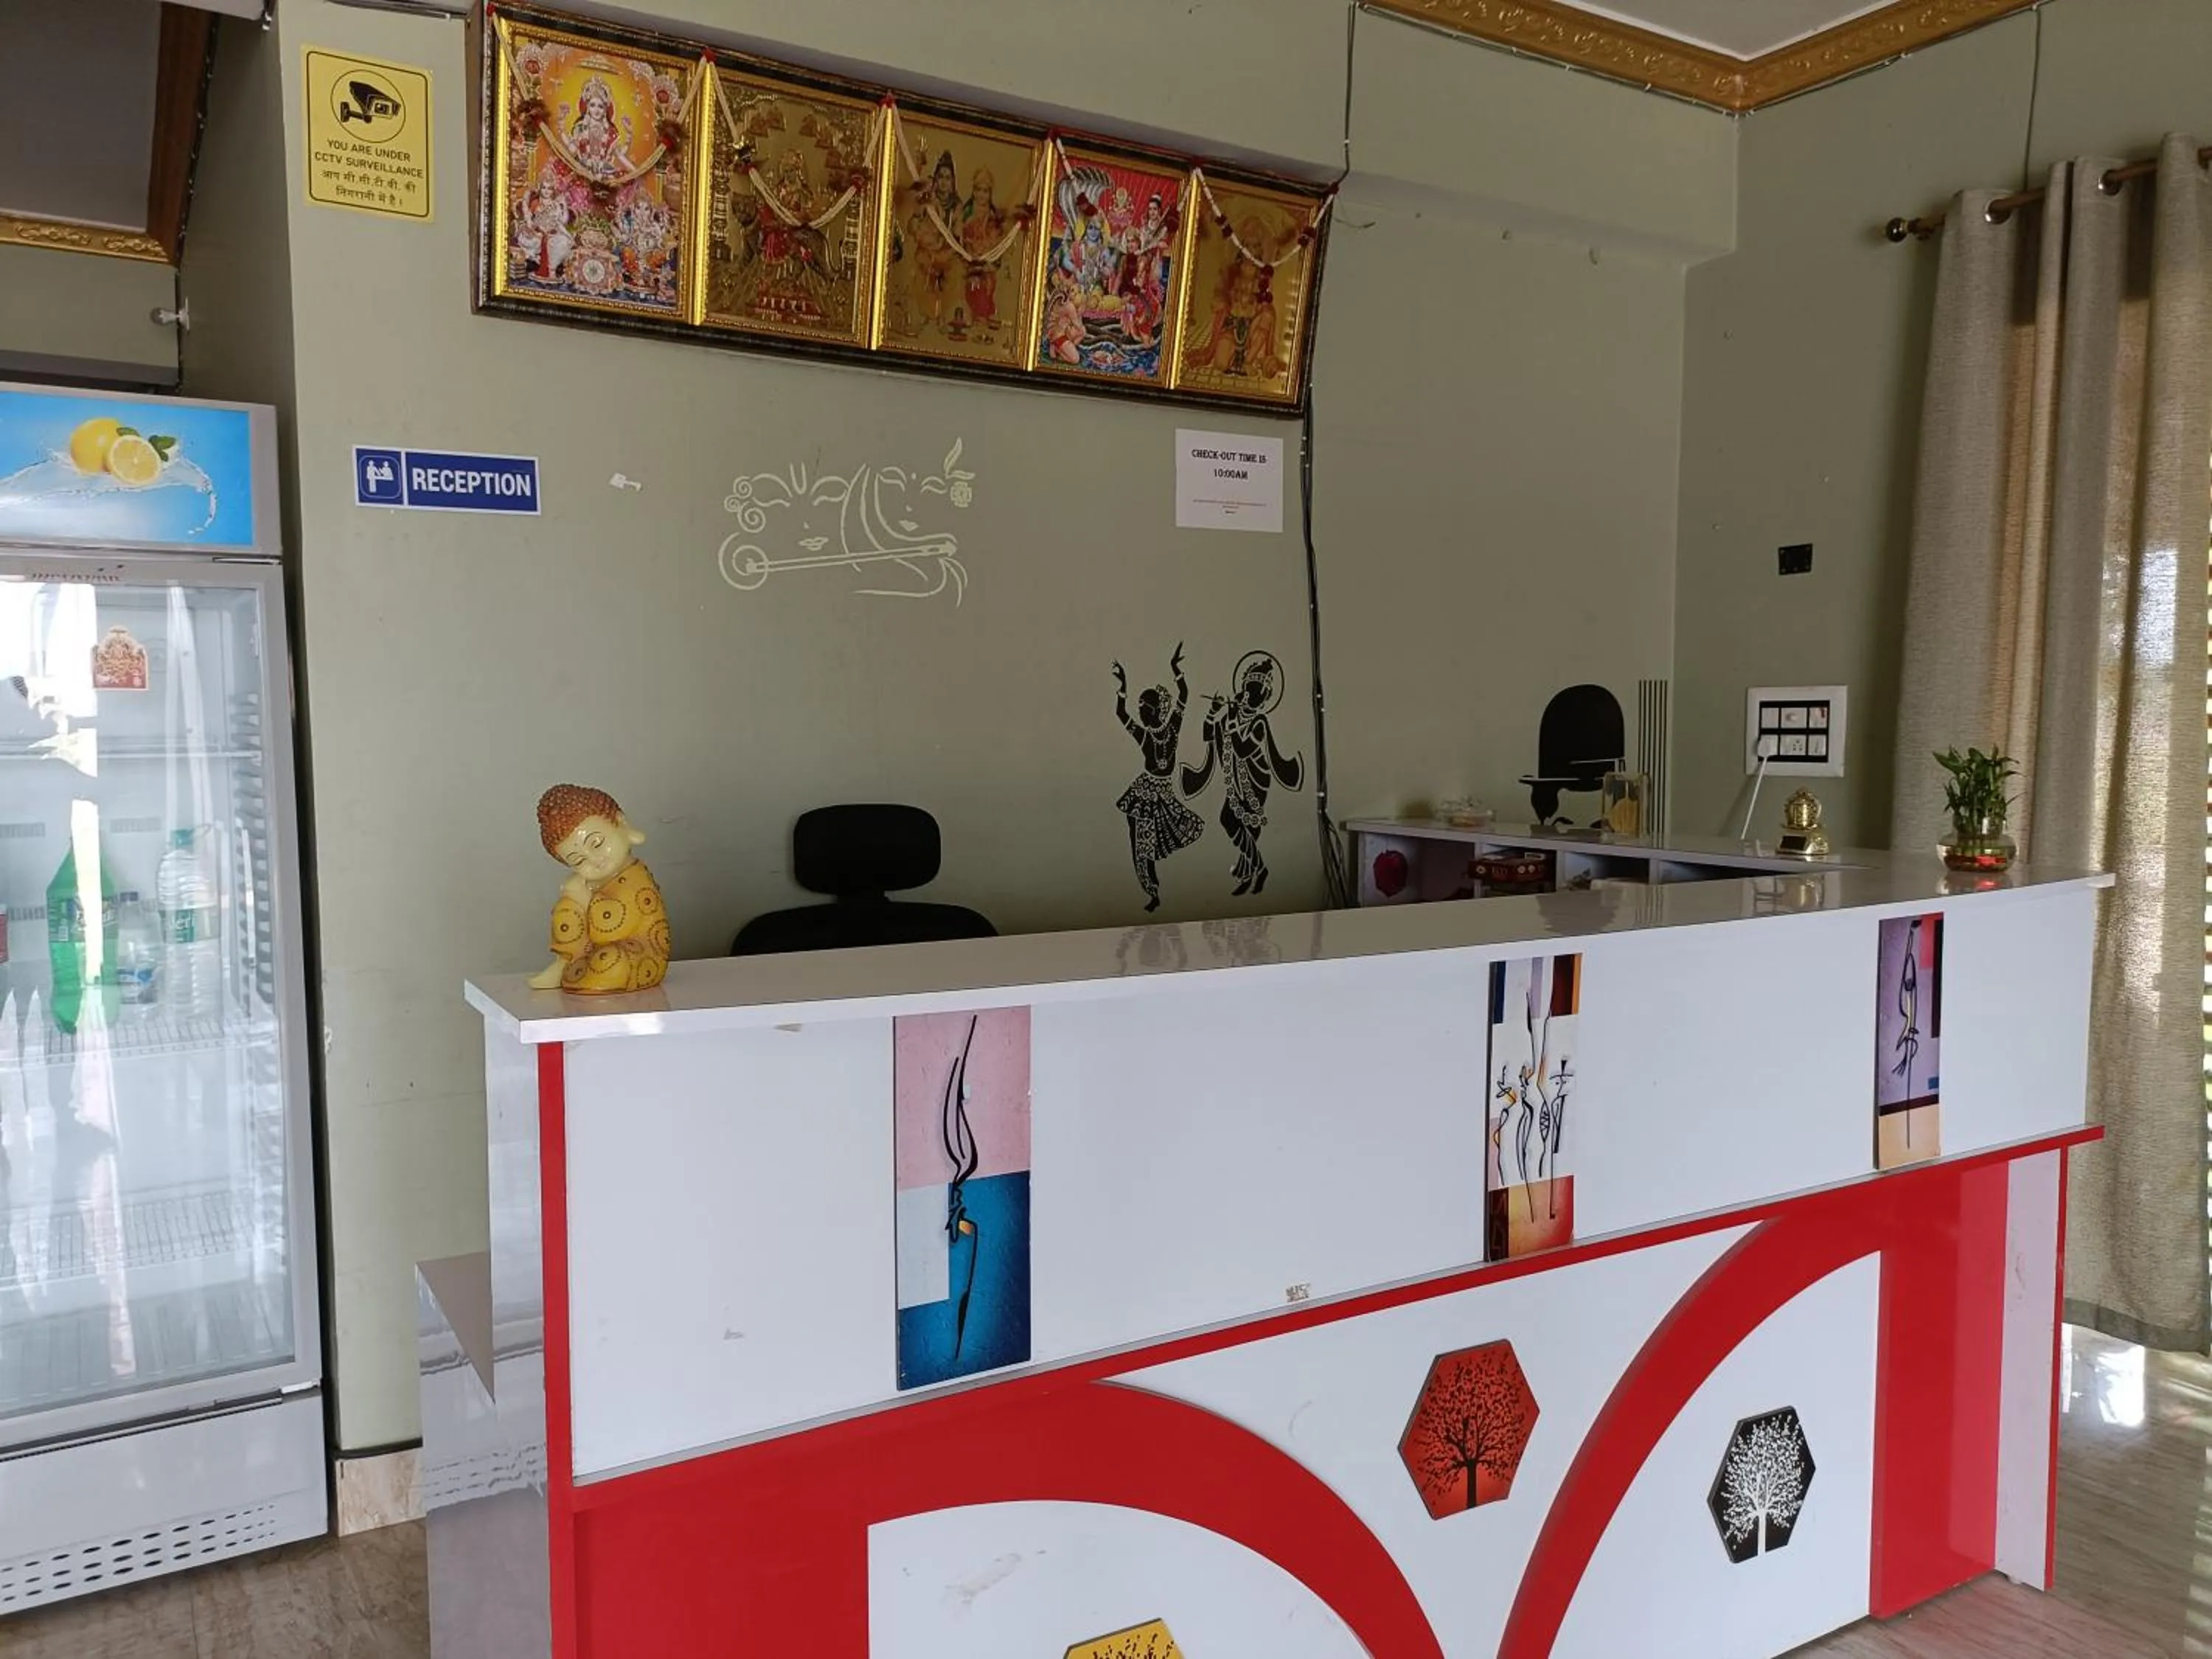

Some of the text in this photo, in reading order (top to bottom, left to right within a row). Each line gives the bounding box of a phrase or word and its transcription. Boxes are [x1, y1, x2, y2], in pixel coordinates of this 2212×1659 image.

[327, 138, 411, 162] YOU ARE UNDER
[315, 151, 424, 178] CCTV SURVEILLANCE
[1192, 449, 1266, 463] CHECK-OUT TIME IS
[411, 467, 532, 497] RECEPTION
